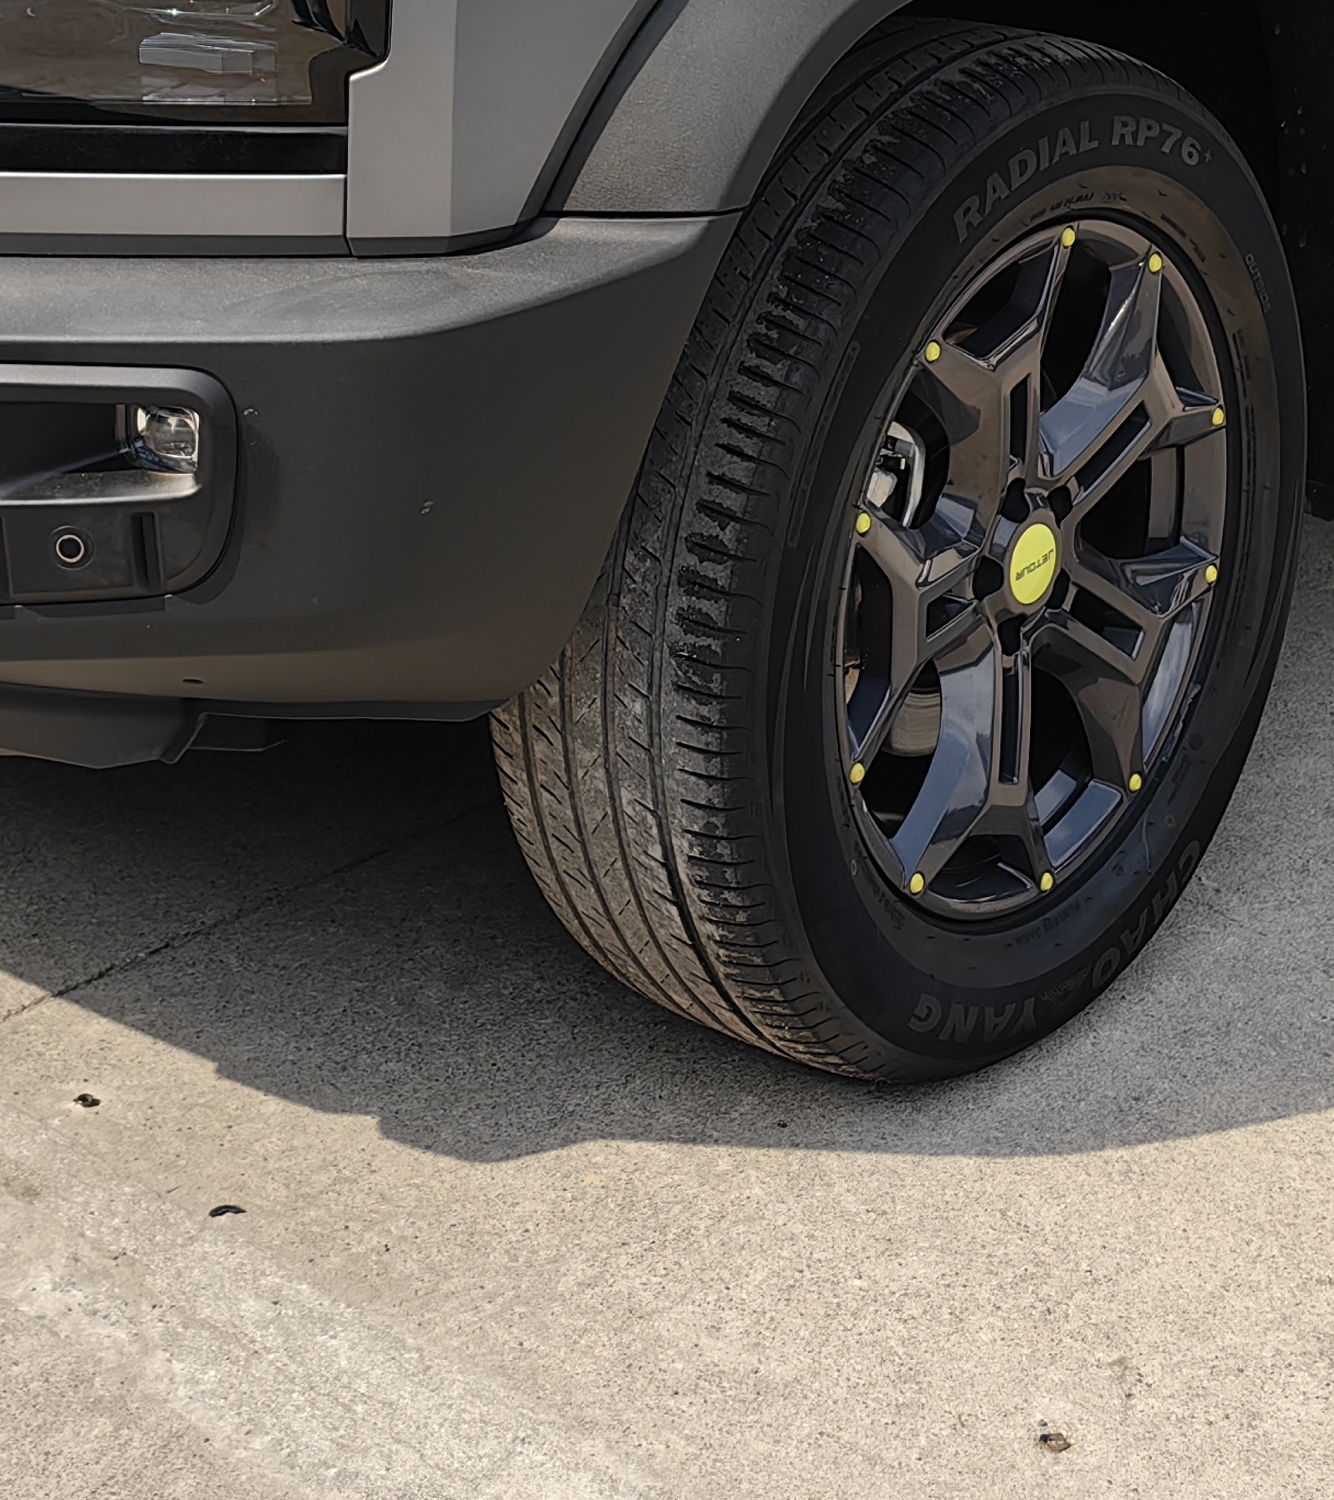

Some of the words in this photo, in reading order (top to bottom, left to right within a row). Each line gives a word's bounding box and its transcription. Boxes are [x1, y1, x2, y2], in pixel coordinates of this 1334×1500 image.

[952, 120, 1099, 244] RADIAL
[1244, 252, 1273, 314] OUTSIDE
[1015, 548, 1055, 581] JETOUR
[1091, 840, 1201, 989] CHAO
[906, 992, 1039, 1043] YANG
